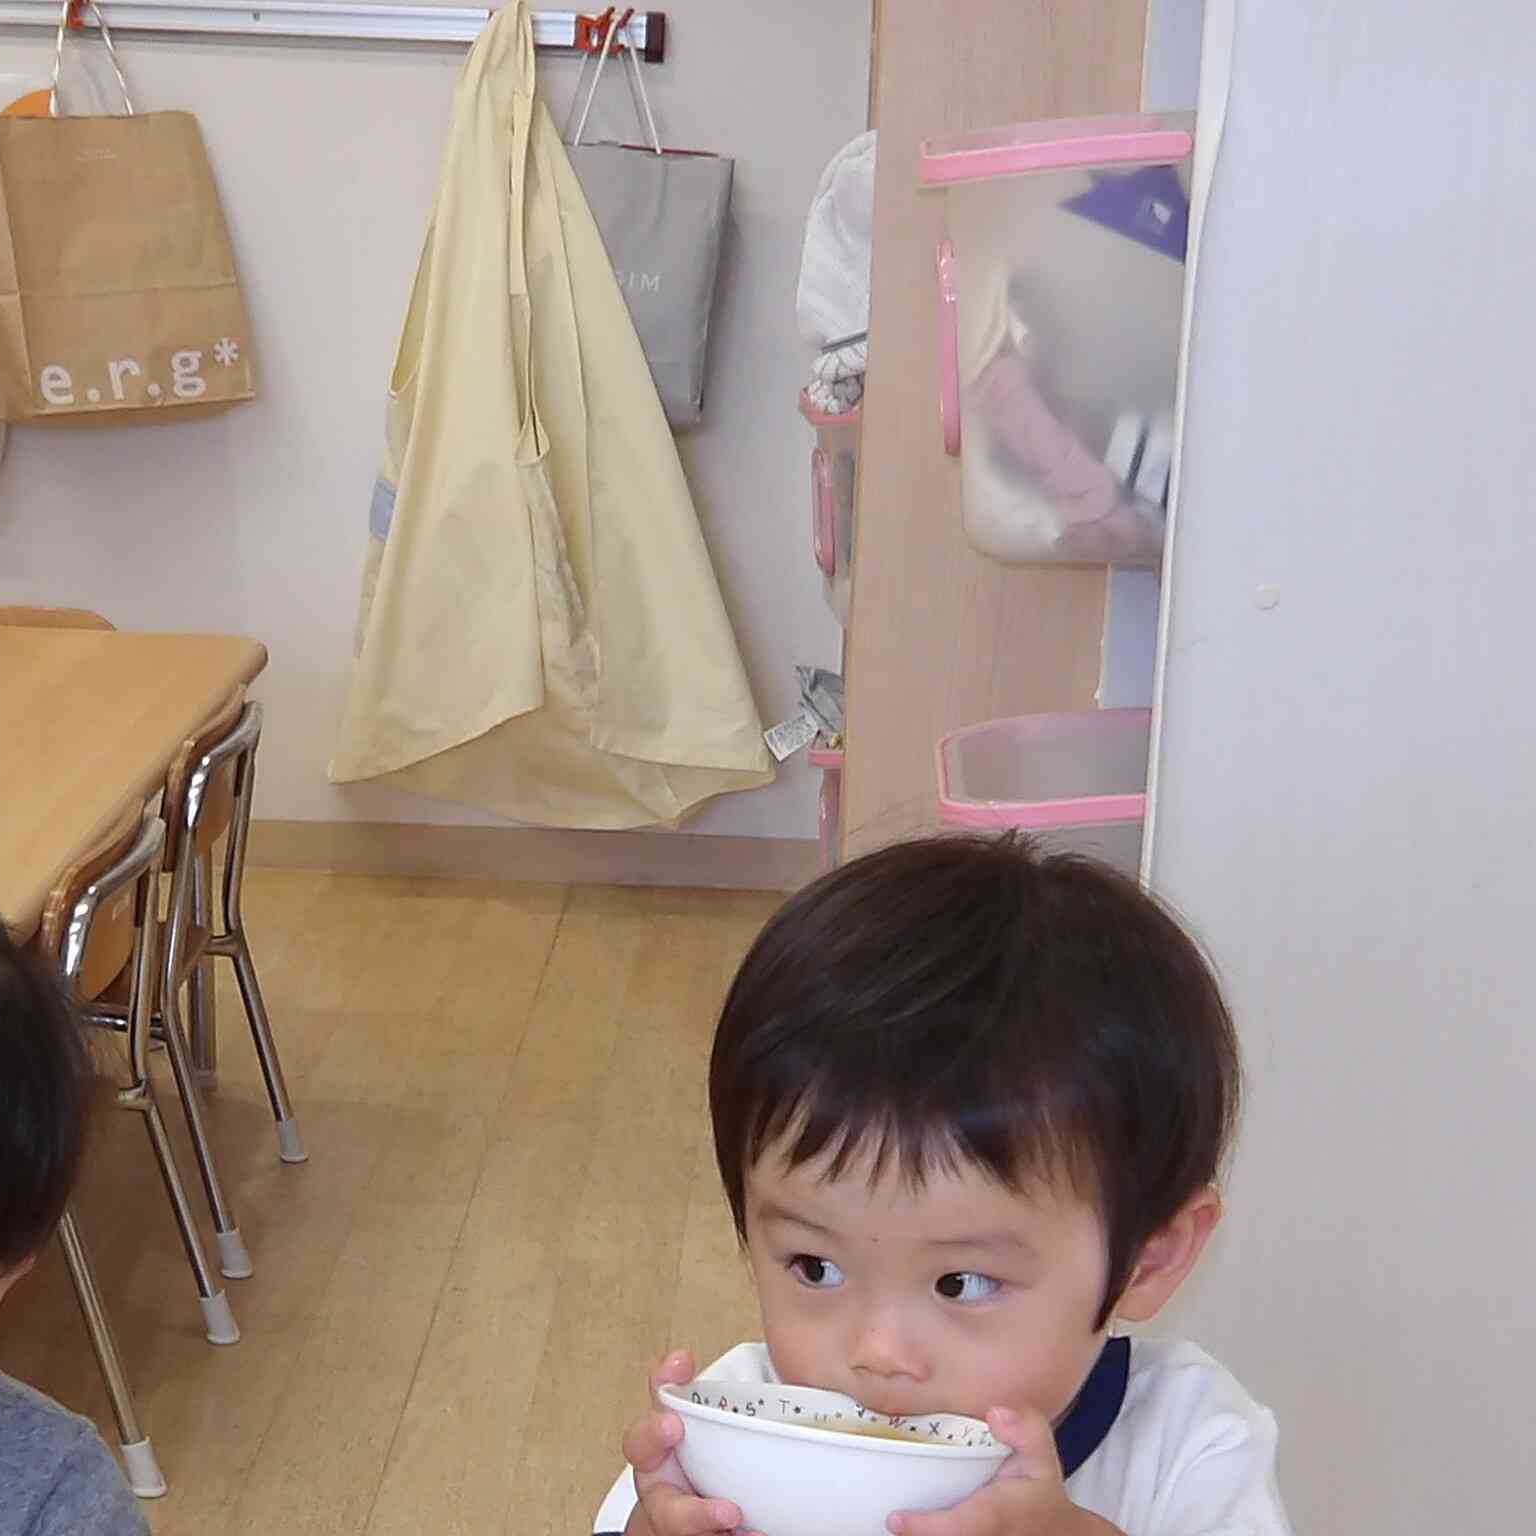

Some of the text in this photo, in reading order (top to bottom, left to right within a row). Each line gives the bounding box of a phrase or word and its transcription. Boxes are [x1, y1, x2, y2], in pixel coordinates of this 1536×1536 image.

[745, 1401, 756, 1416] S
[779, 1400, 790, 1414] T
[928, 1421, 941, 1436] X
